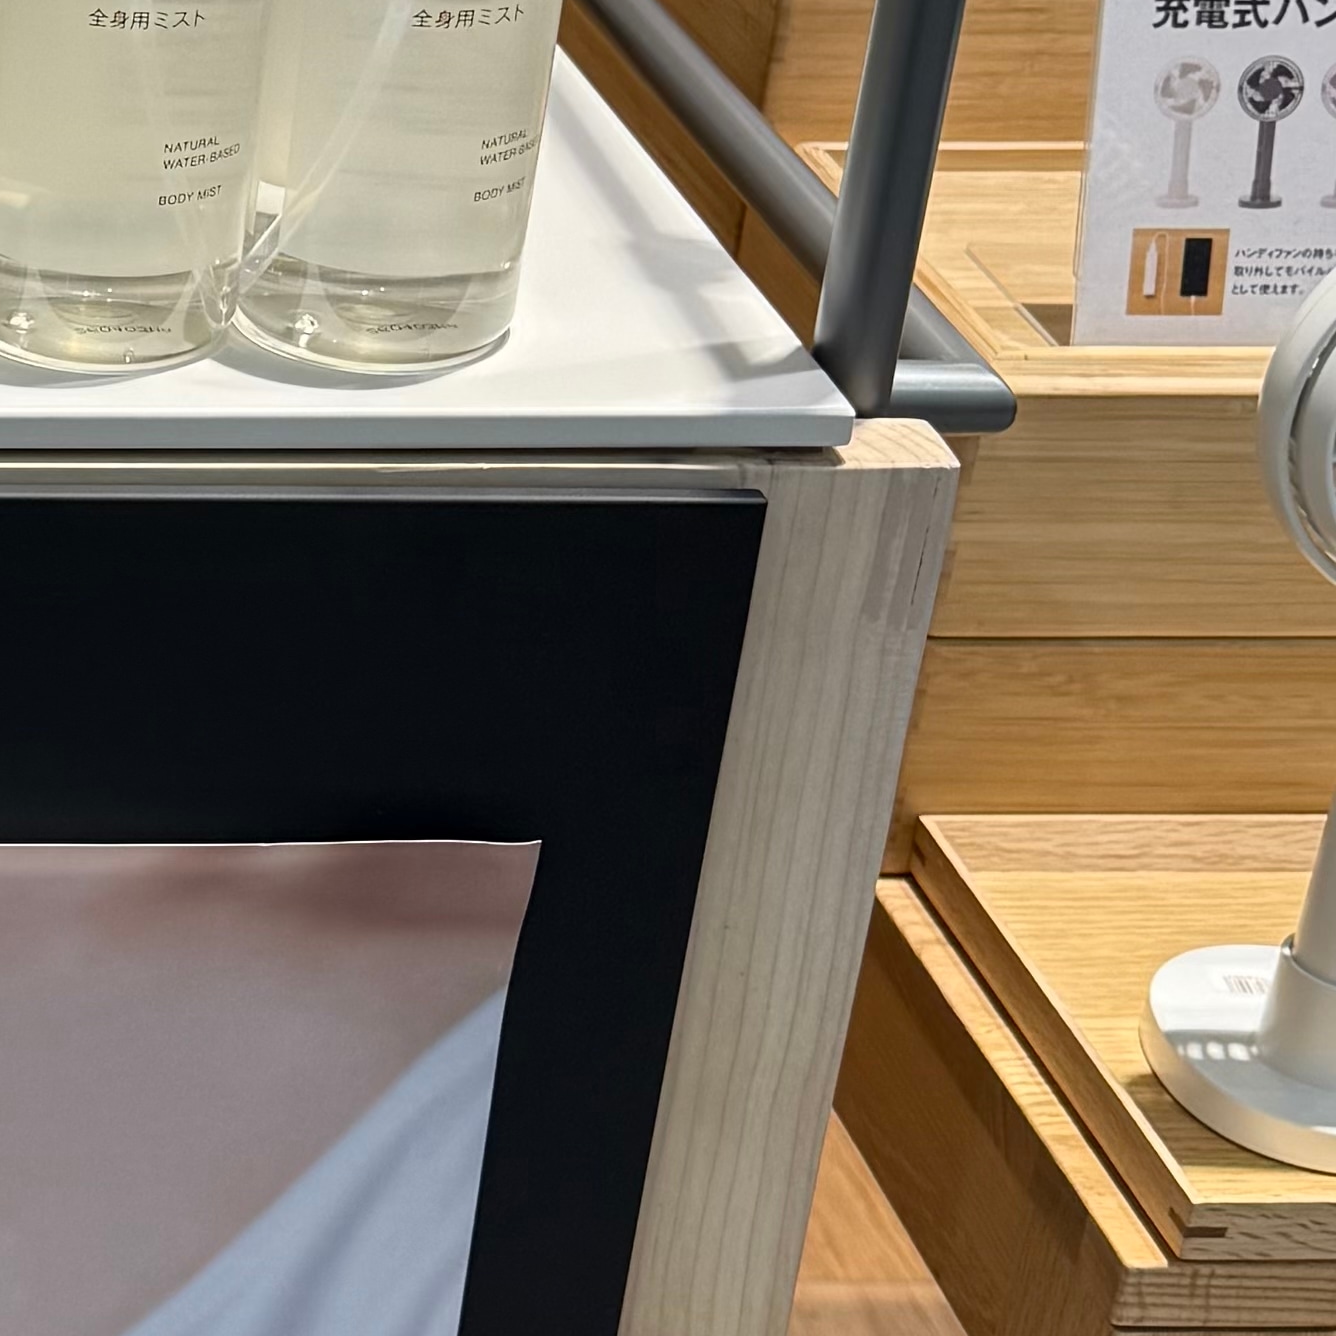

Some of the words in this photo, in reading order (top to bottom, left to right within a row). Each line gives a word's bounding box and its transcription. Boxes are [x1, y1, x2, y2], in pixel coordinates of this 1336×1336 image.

[88, 9, 206, 30] 全身用ミスト
[412, 4, 525, 29] 全身用ミスト
[163, 135, 220, 154] NATURAL
[158, 192, 194, 207] BODY
[1235, 248, 1336, 260] ハンディファンの持ち
